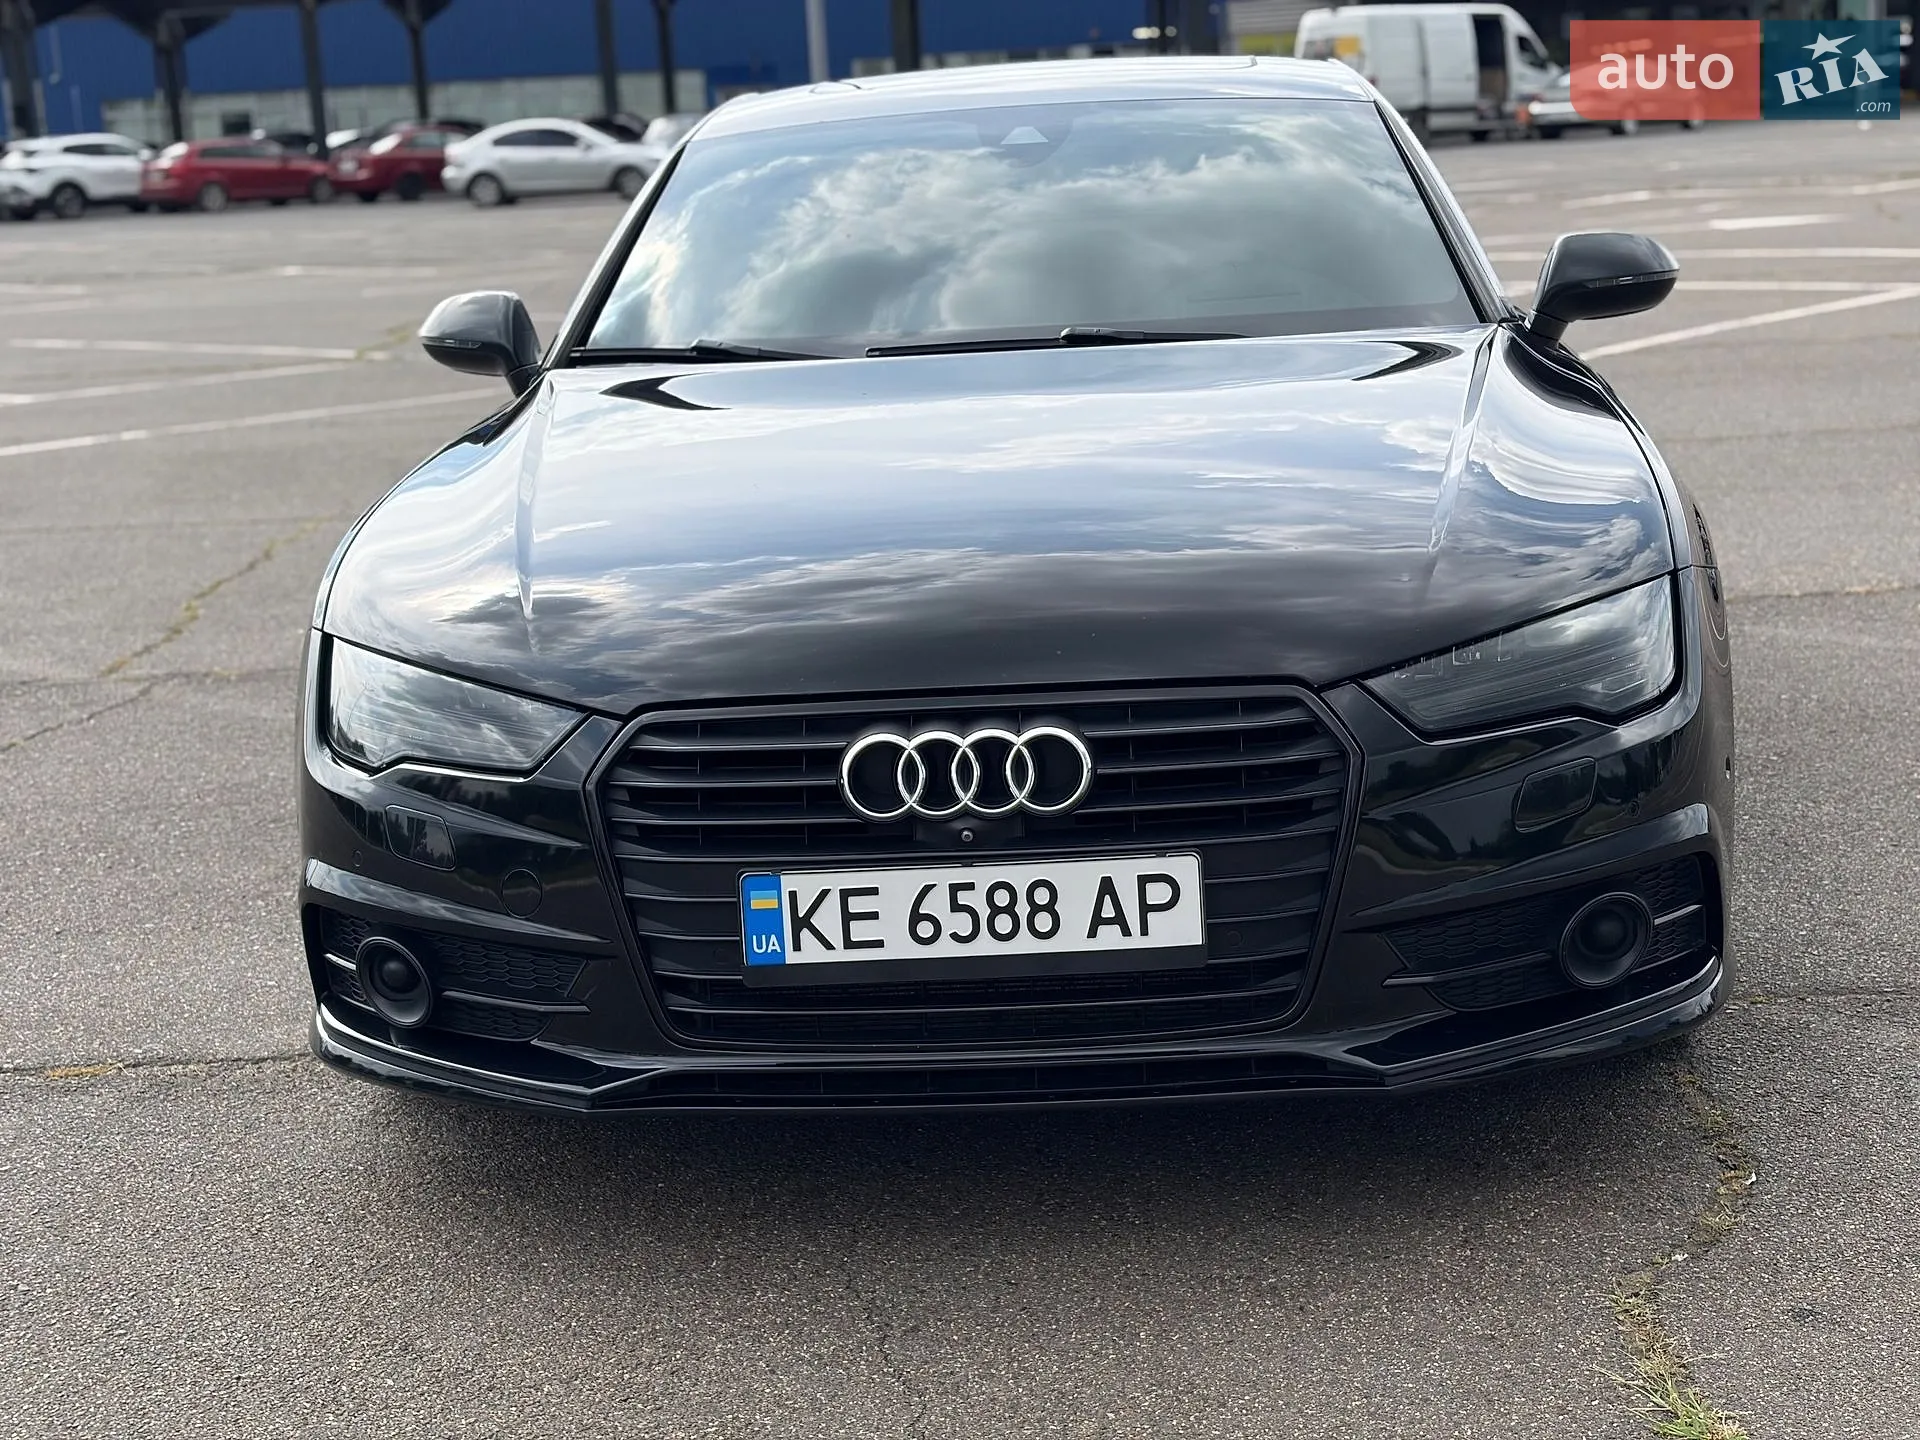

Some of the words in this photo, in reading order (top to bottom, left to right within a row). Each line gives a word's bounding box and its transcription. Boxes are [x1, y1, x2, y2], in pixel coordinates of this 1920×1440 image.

[787, 886, 885, 952] KE
[907, 878, 1062, 946] 6588
[1086, 873, 1182, 939] AP
[752, 935, 782, 954] UA
